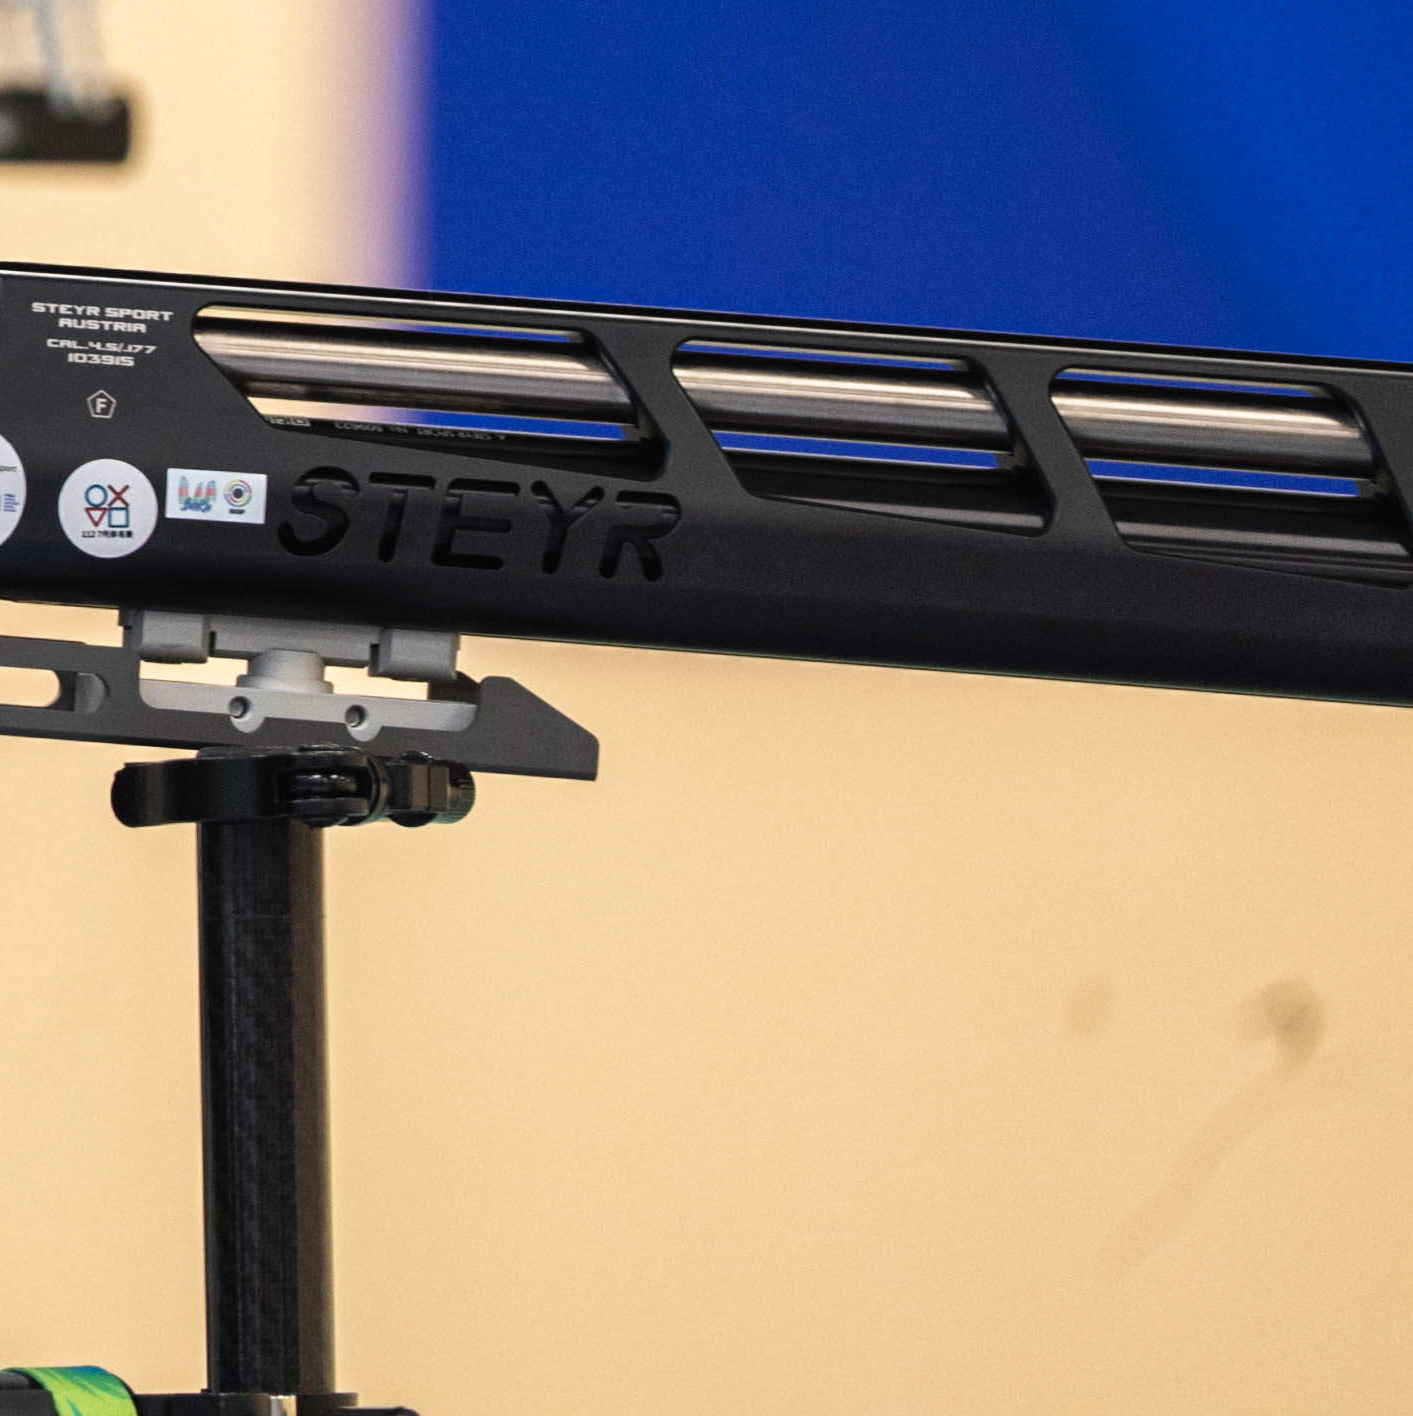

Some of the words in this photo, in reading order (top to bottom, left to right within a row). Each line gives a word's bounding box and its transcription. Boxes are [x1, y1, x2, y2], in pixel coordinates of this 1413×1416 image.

[31, 302, 101, 317] STEYR
[104, 307, 174, 321] SPORT
[58, 317, 147, 333] AUSTRIA
[67, 352, 135, 367] 103915
[95, 398, 108, 413] F
[277, 465, 682, 582] STEYR
